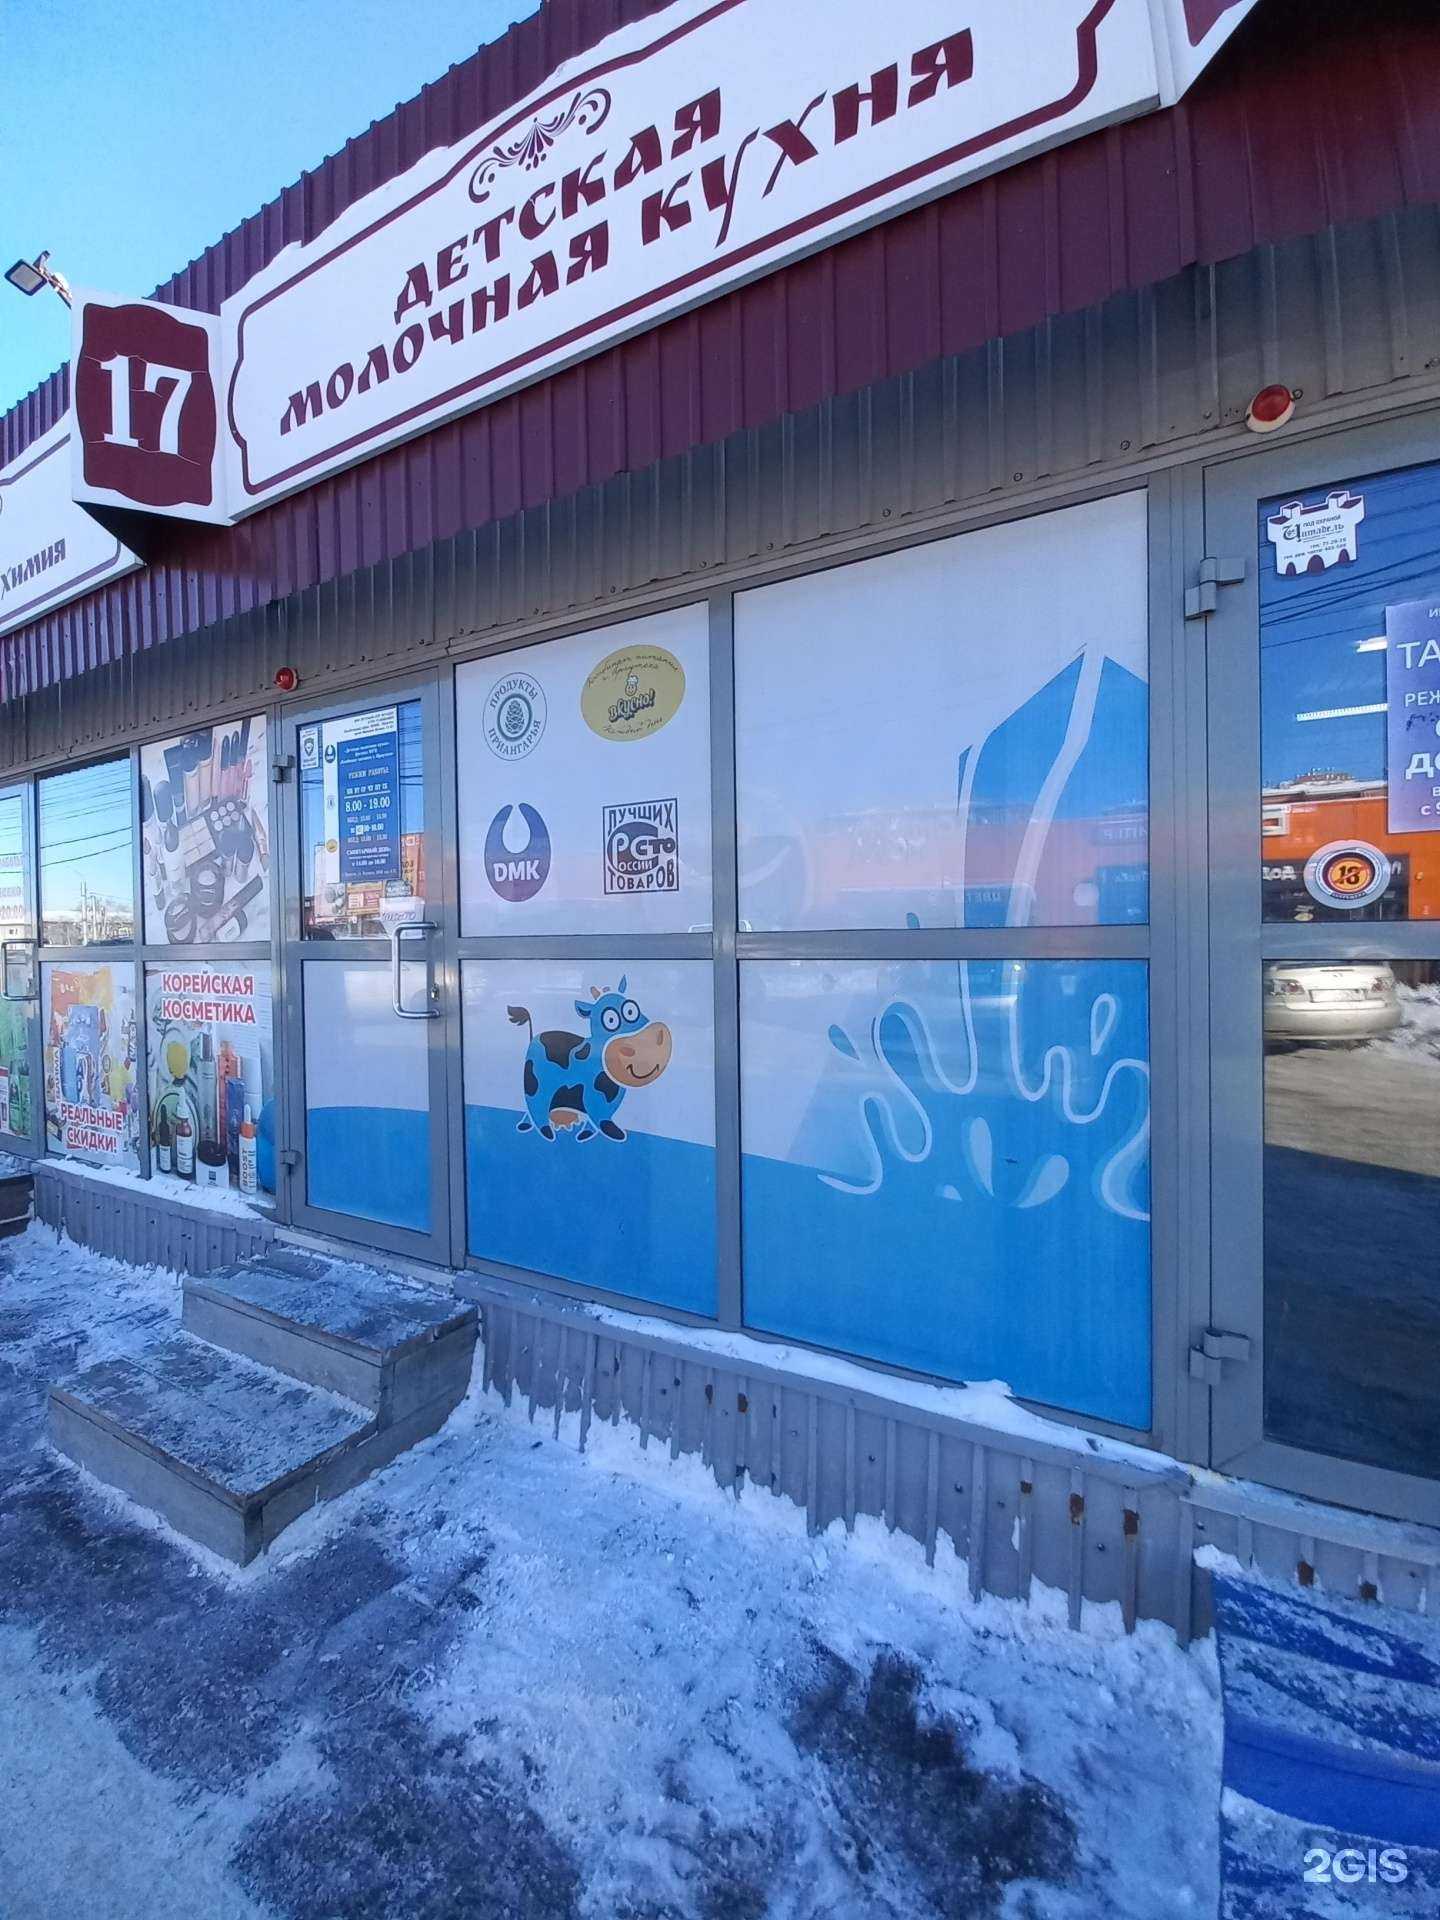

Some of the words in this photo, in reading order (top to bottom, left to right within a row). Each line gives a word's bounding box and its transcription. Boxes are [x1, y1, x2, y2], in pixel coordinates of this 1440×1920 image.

[395, 88, 721, 323] ДЕТСКАЯ
[280, 219, 609, 435] МОЛОЧНАЯ
[641, 27, 974, 248] КУХНЯ
[101, 354, 192, 455] 17
[0, 538, 66, 600] ХИМИЯ
[490, 679, 538, 710] ПРОДУКТЫ
[489, 720, 541, 755] ПРИАНГАРЬЯ
[606, 803, 674, 837] ЛУЧШИХ
[493, 860, 540, 882] DMK
[605, 859, 675, 891] ТОВАРОВ
[163, 970, 254, 996] КОРЕЙСКАЯ
[163, 1000, 256, 1023] КОСМЕТИКА
[61, 1103, 123, 1131] РЕАЛЬНЫЕ
[67, 1127, 117, 1153] СКИДКИ!
